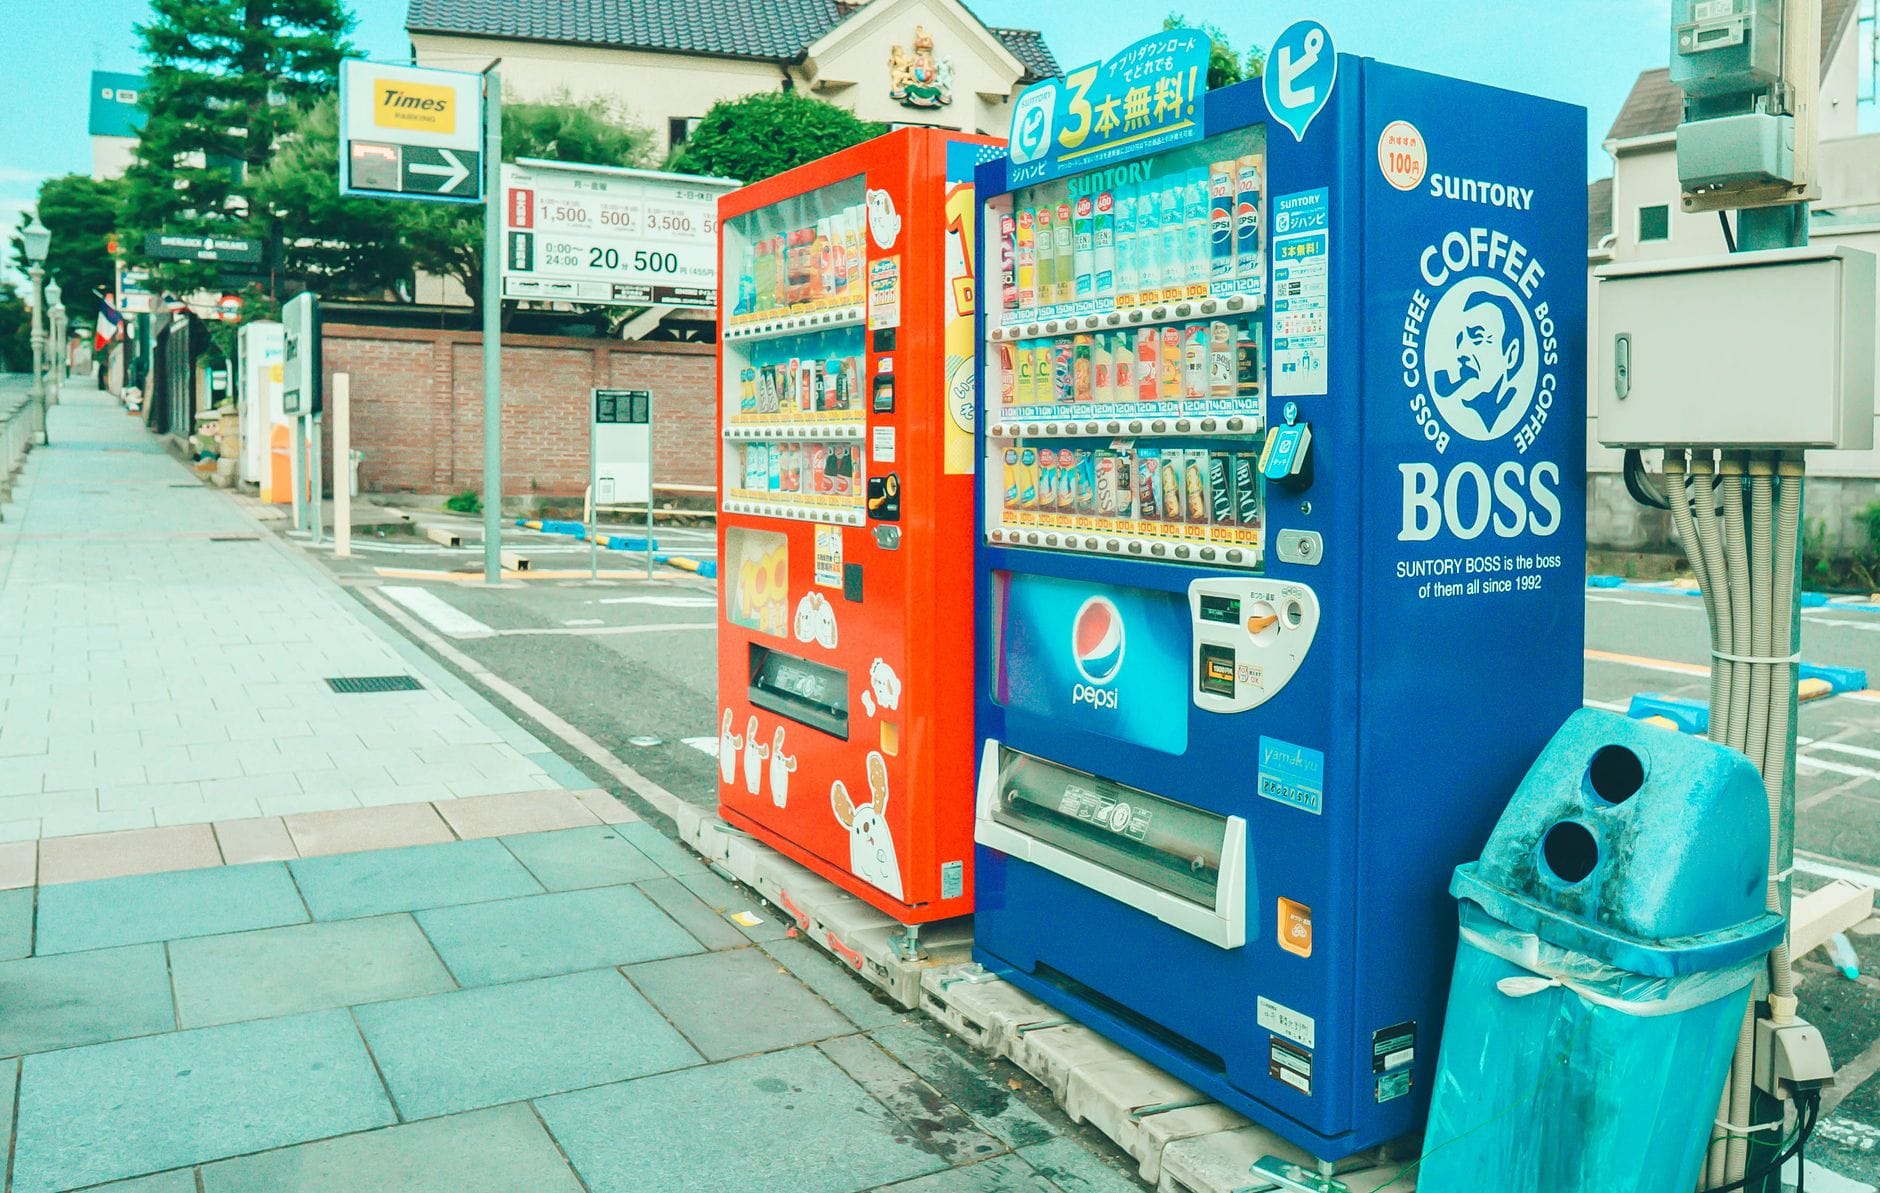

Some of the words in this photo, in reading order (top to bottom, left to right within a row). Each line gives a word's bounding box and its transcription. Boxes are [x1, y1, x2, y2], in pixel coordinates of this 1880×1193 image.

[1109, 37, 1196, 78] アプリダウンロード
[1124, 56, 1174, 83] でどれでも
[384, 89, 447, 112] Times
[1058, 65, 1198, 149] 3本無料!
[1012, 160, 1048, 183] ジハンピ
[1067, 158, 1154, 199] SUNTORY
[1280, 194, 1320, 210] SUNTORY
[1430, 173, 1534, 211] SUNTORY
[541, 206, 586, 223] 1,500
[600, 211, 630, 226] 500
[647, 215, 690, 231] 3,500
[1290, 212, 1326, 229] ジハンピ
[545, 254, 578, 266] 24:00
[589, 247, 619, 269] 20
[633, 251, 678, 274] 500
[1420, 227, 1546, 300] COFFEE
[1211, 281, 1233, 293] 120円
[1235, 277, 1259, 290] 120円
[1401, 288, 1431, 388] COFFEE
[1534, 301, 1558, 366] BOSS
[1410, 393, 1451, 455] BOSS
[1513, 372, 1557, 455] COFFEE
[1210, 463, 1232, 521] BLACK
[1237, 463, 1259, 523] BLACK
[1397, 461, 1562, 541] BOSS
[1396, 558, 1463, 578] SUNTORY
[1466, 556, 1501, 574] BOSS
[1504, 556, 1514, 571] is
[1516, 554, 1533, 570] the
[1536, 553, 1561, 569] boss
[1418, 582, 1431, 599] of
[1434, 581, 1463, 597] them
[1466, 579, 1480, 595] all
[1482, 577, 1512, 594] since
[1515, 575, 1542, 590] 1992
[1072, 683, 1118, 710] pepsi
[1264, 747, 1318, 772] yamakyu
